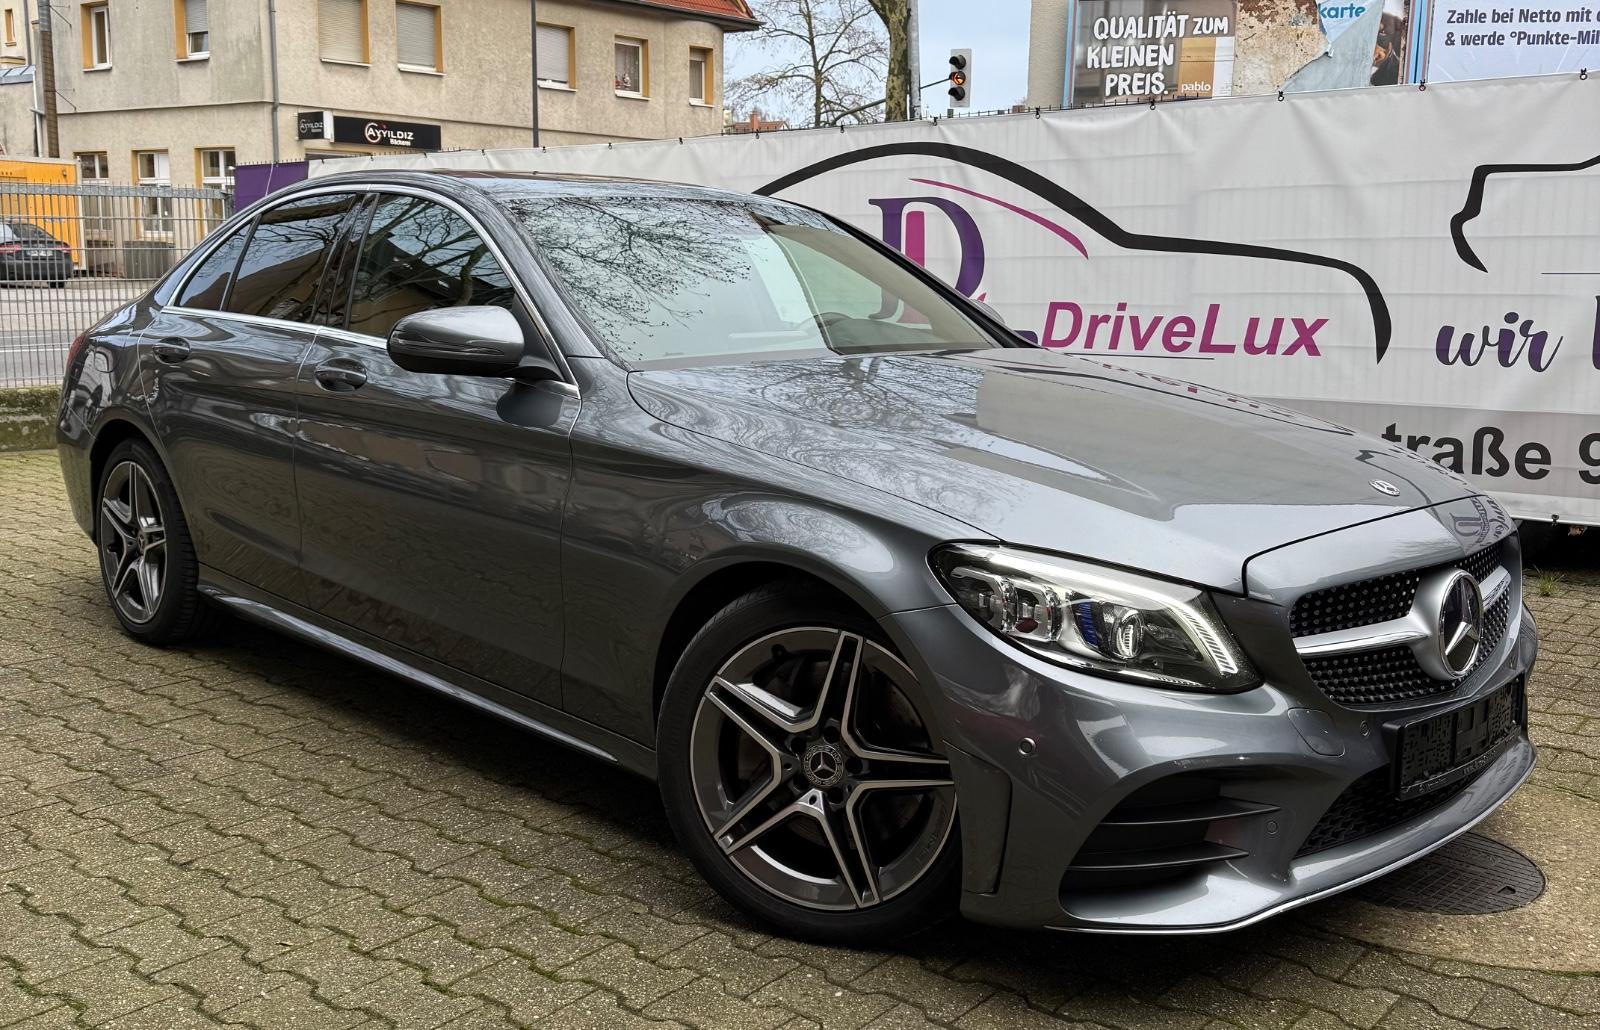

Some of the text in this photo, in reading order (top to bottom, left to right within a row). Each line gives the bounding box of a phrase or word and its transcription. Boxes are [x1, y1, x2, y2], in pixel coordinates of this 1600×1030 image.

[1093, 10, 1229, 40] QUALITÄT ZUM
[1447, 9, 1487, 24] Zahle
[1491, 8, 1514, 23] bei
[1518, 9, 1561, 23] Netto
[1566, 7, 1592, 23] mit
[1445, 31, 1456, 46] &
[1460, 31, 1505, 46] werde
[1087, 43, 1175, 69] KLEINEN
[1105, 72, 1168, 97] PREIS.
[1181, 81, 1211, 93] pablo
[367, 126, 414, 140] AYYILDIZ
[1041, 301, 1330, 357] DriveLux
[1436, 312, 1564, 372] wir
